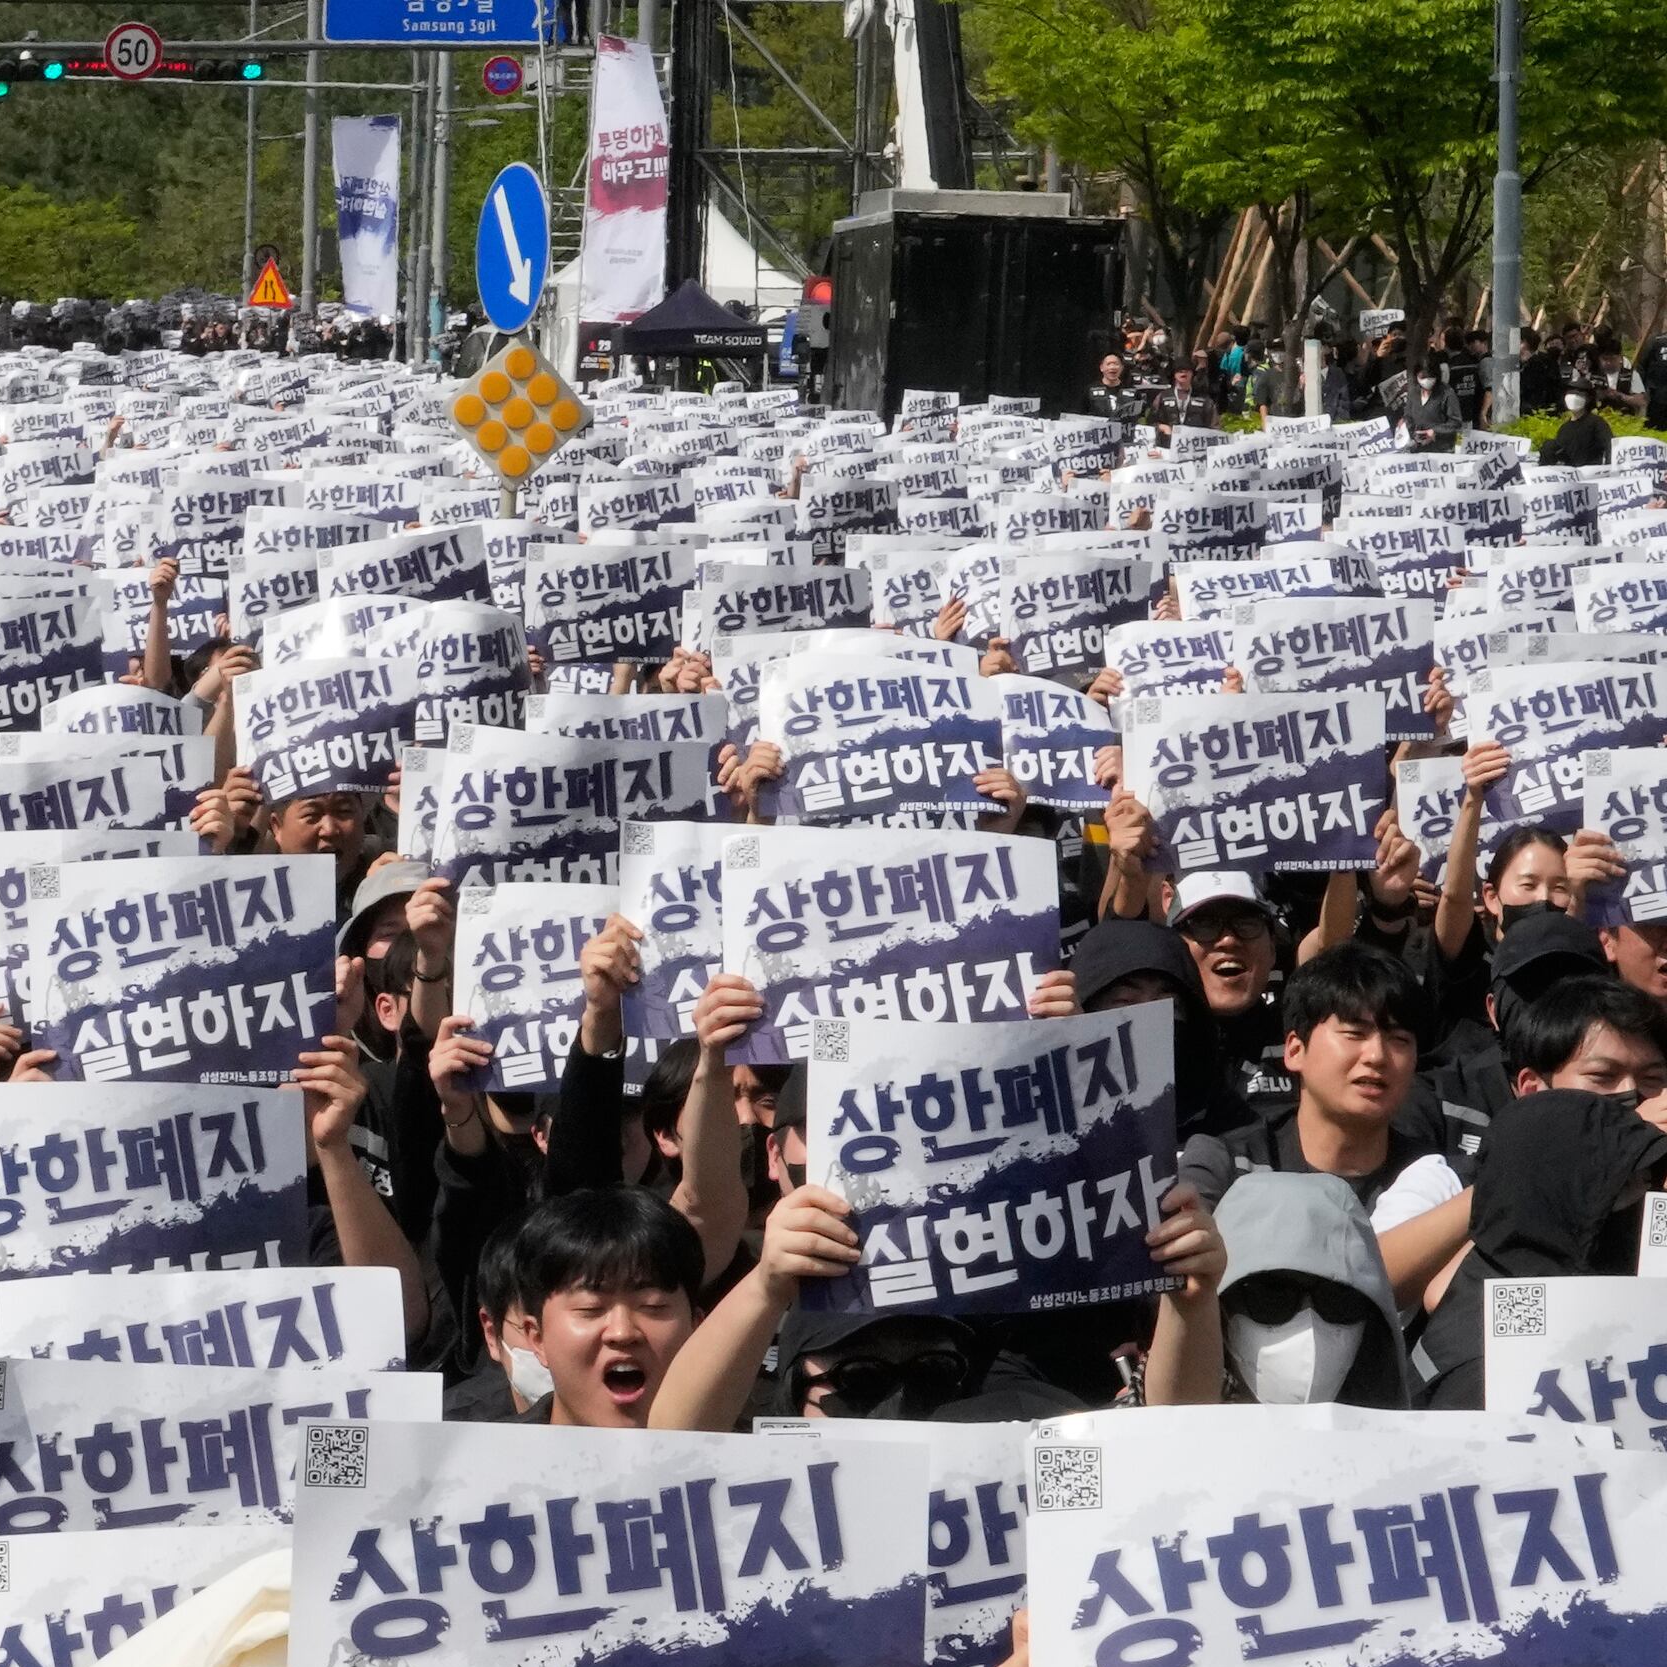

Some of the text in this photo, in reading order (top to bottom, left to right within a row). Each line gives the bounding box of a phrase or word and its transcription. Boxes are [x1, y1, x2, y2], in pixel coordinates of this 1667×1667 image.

[118, 38, 149, 69] 50
[403, 18, 496, 34] Samsung 3gil
[598, 123, 664, 150] 투명하게
[601, 157, 668, 184] 바꾸고!!!
[694, 334, 762, 346] TEAM SOUND
[1057, 420, 1119, 452] 상한폐지
[307, 482, 407, 512] 상한폐지
[588, 486, 683, 531] 상한폐지
[1161, 494, 1257, 541] 상한폐지
[331, 543, 466, 595] 상한폐지
[1345, 524, 1455, 574] 상한폐지
[553, 557, 672, 605] 상한폐지
[1010, 561, 1133, 623] 상한폐지
[549, 607, 684, 661] 실현하자
[1249, 609, 1410, 673] 상한폐지
[247, 663, 393, 742] 상한폐지
[787, 675, 970, 740] 상한폐지
[1490, 670, 1658, 747] 상한폐지
[262, 726, 405, 800] 실현하자
[1152, 698, 1352, 790] 상한폐지
[453, 747, 671, 834] 상한폐지
[797, 744, 1003, 813] 실현하자
[1171, 780, 1382, 870] 실현하자
[50, 867, 293, 984] 상한폐지
[752, 844, 1018, 956] 상한폐지
[71, 972, 334, 1082] 실현하자
[200, 1070, 279, 1085] 삼성전자노동조합
[829, 1016, 1138, 1172] 상한폐지
[857, 1151, 1179, 1310] 실현하자
[1029, 1274, 1186, 1311] 삼성전자노동조합 공동투쟁본부
[332, 1463, 844, 1654] 상한폐지
